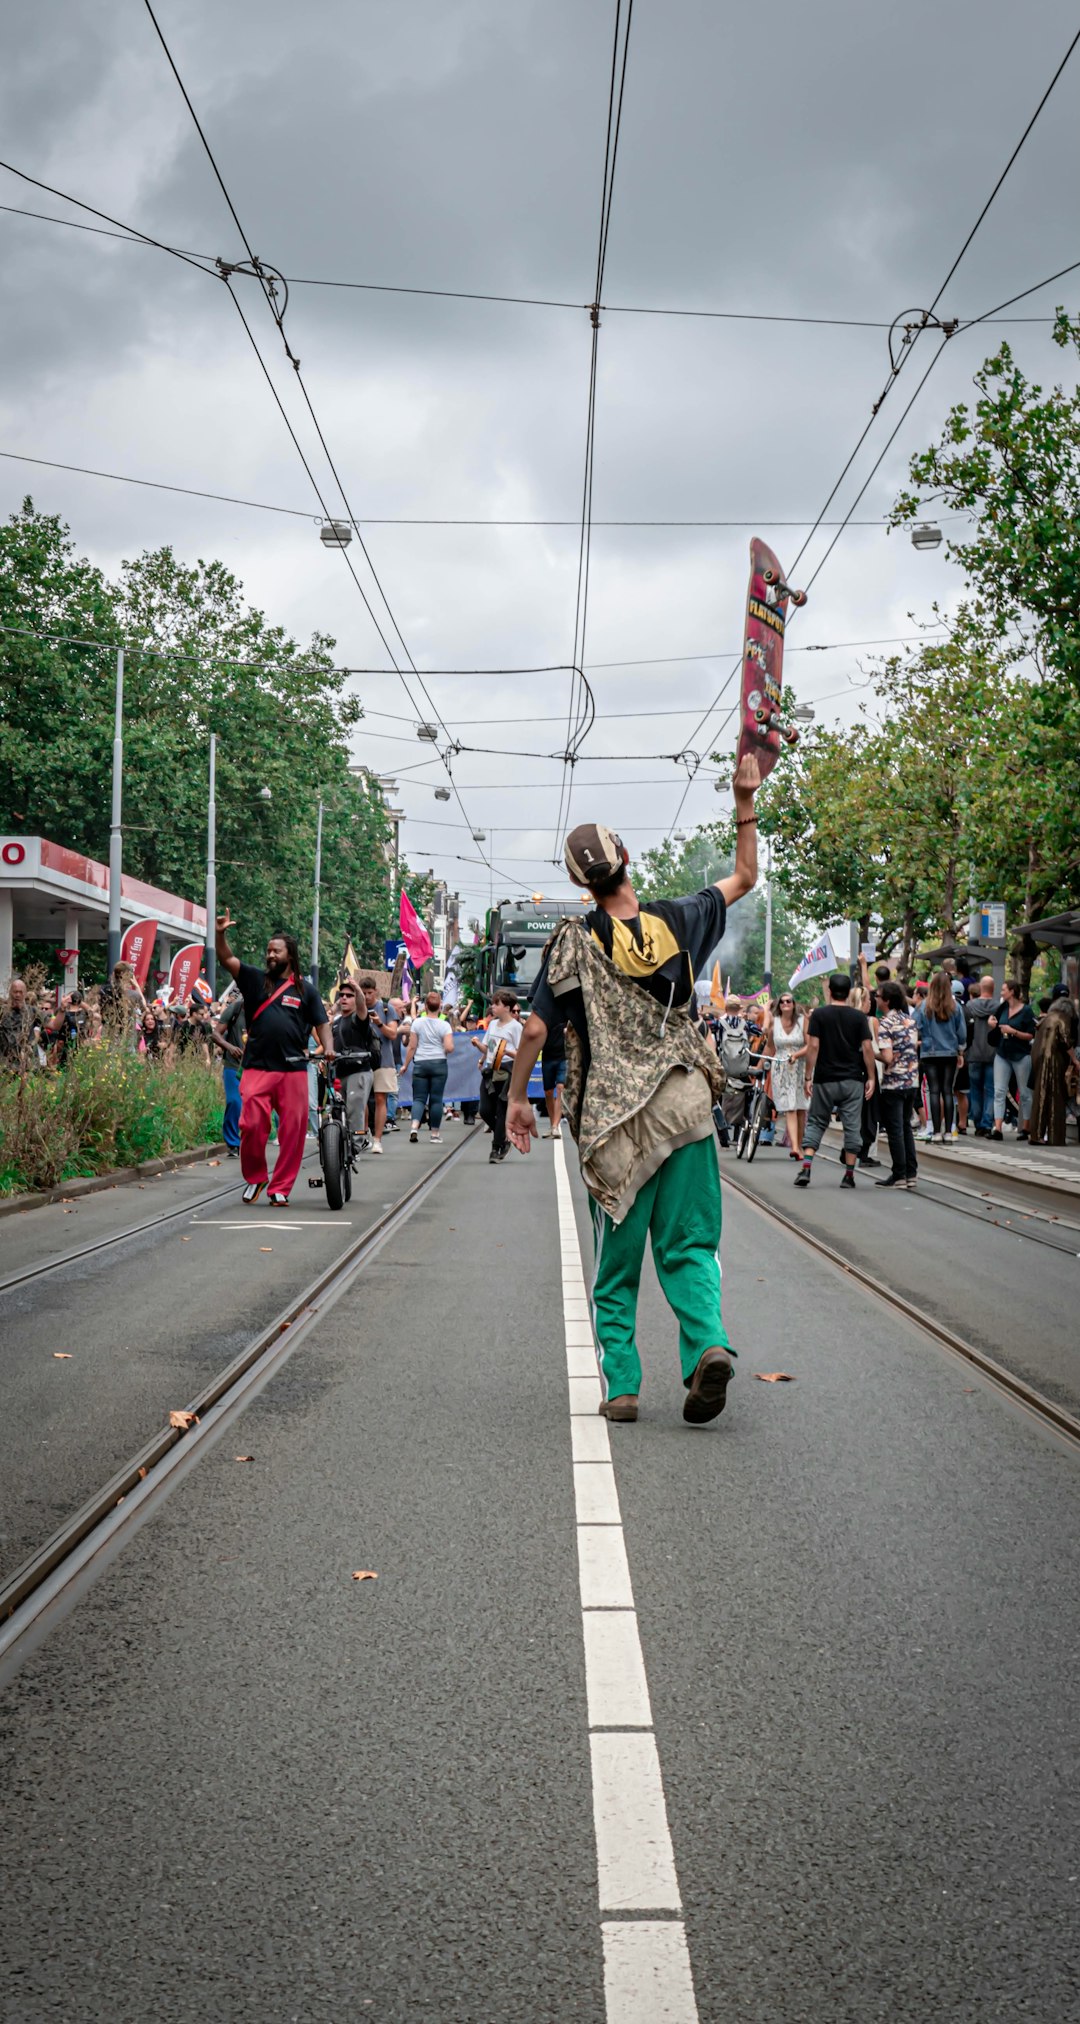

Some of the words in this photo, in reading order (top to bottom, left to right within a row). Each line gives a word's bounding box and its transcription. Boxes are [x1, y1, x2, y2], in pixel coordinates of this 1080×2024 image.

[0, 843, 25, 865] O
[583, 849, 595, 862] 1
[527, 922, 557, 930] POWER
